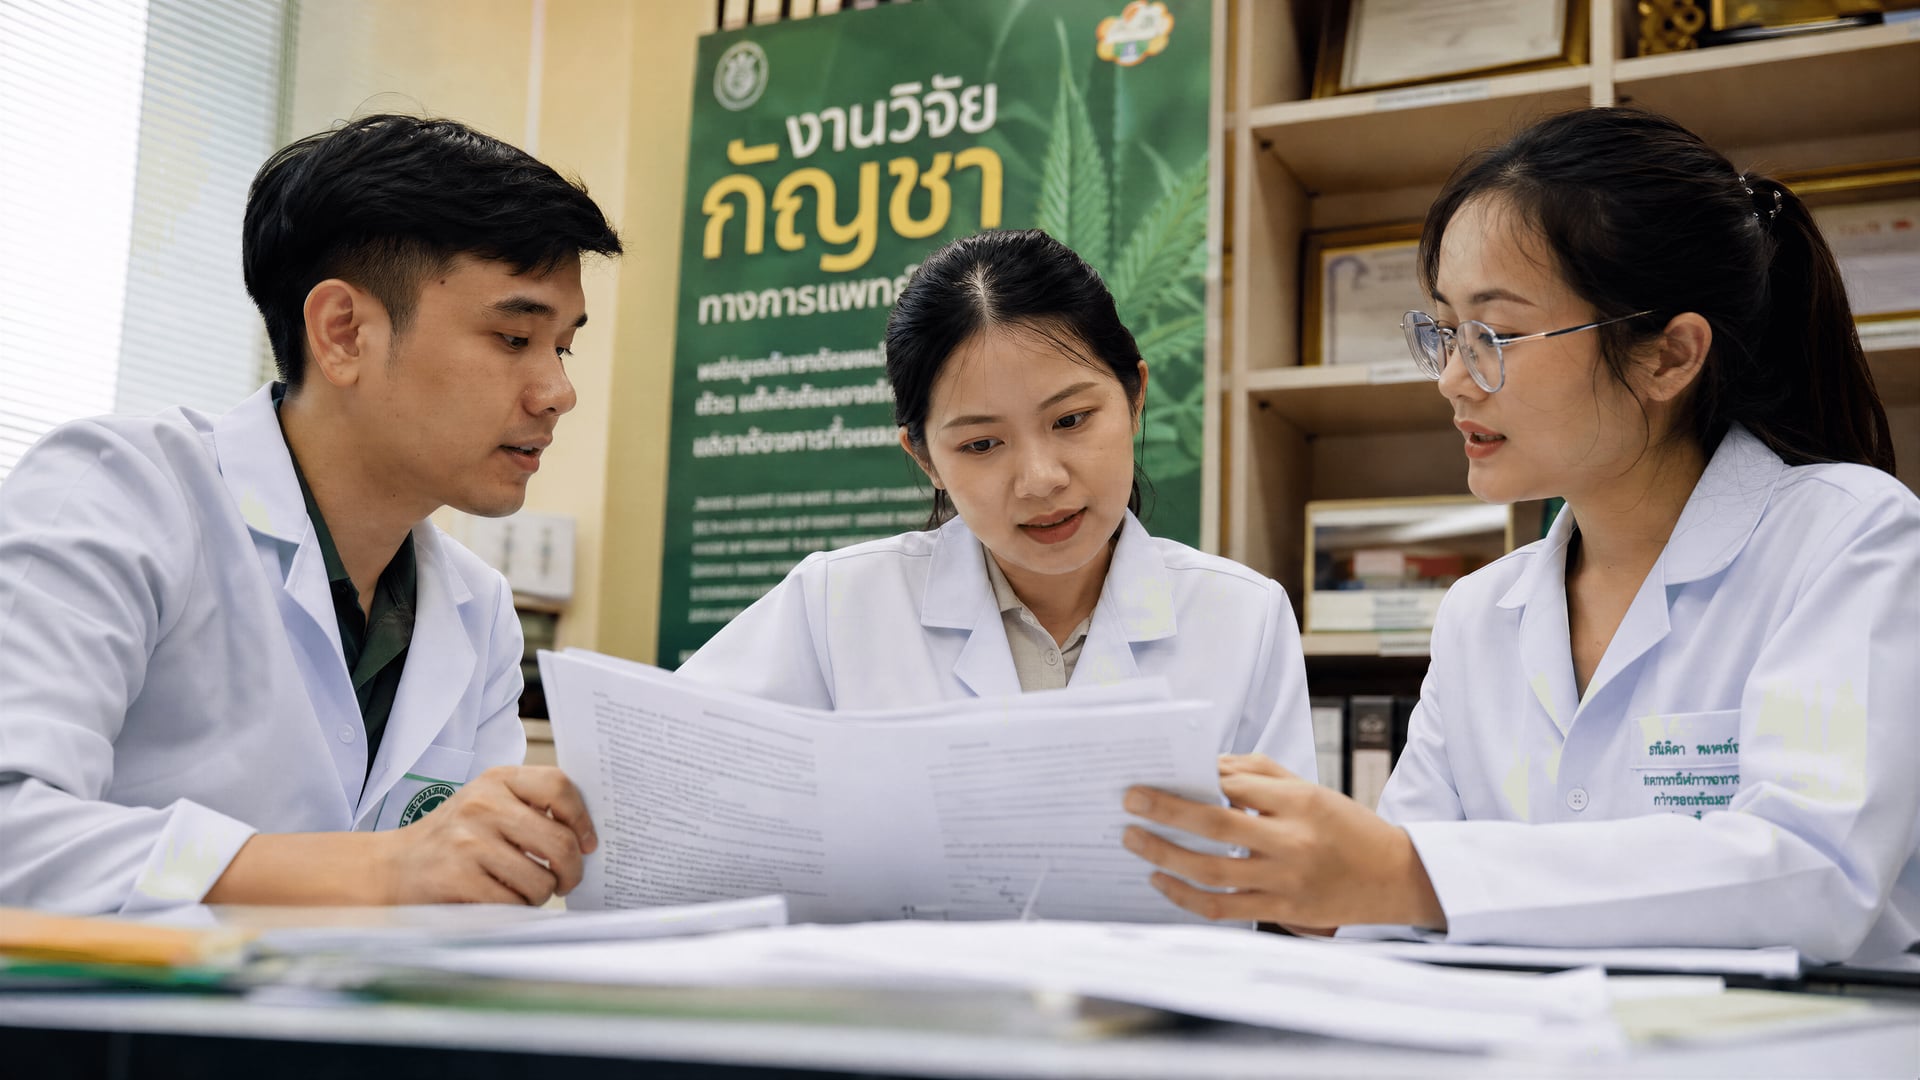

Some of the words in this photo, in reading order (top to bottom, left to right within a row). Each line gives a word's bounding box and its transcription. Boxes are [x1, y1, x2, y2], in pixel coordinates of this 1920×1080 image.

[786, 74, 997, 158] งานวิจัย
[702, 140, 1004, 272] กัญชา
